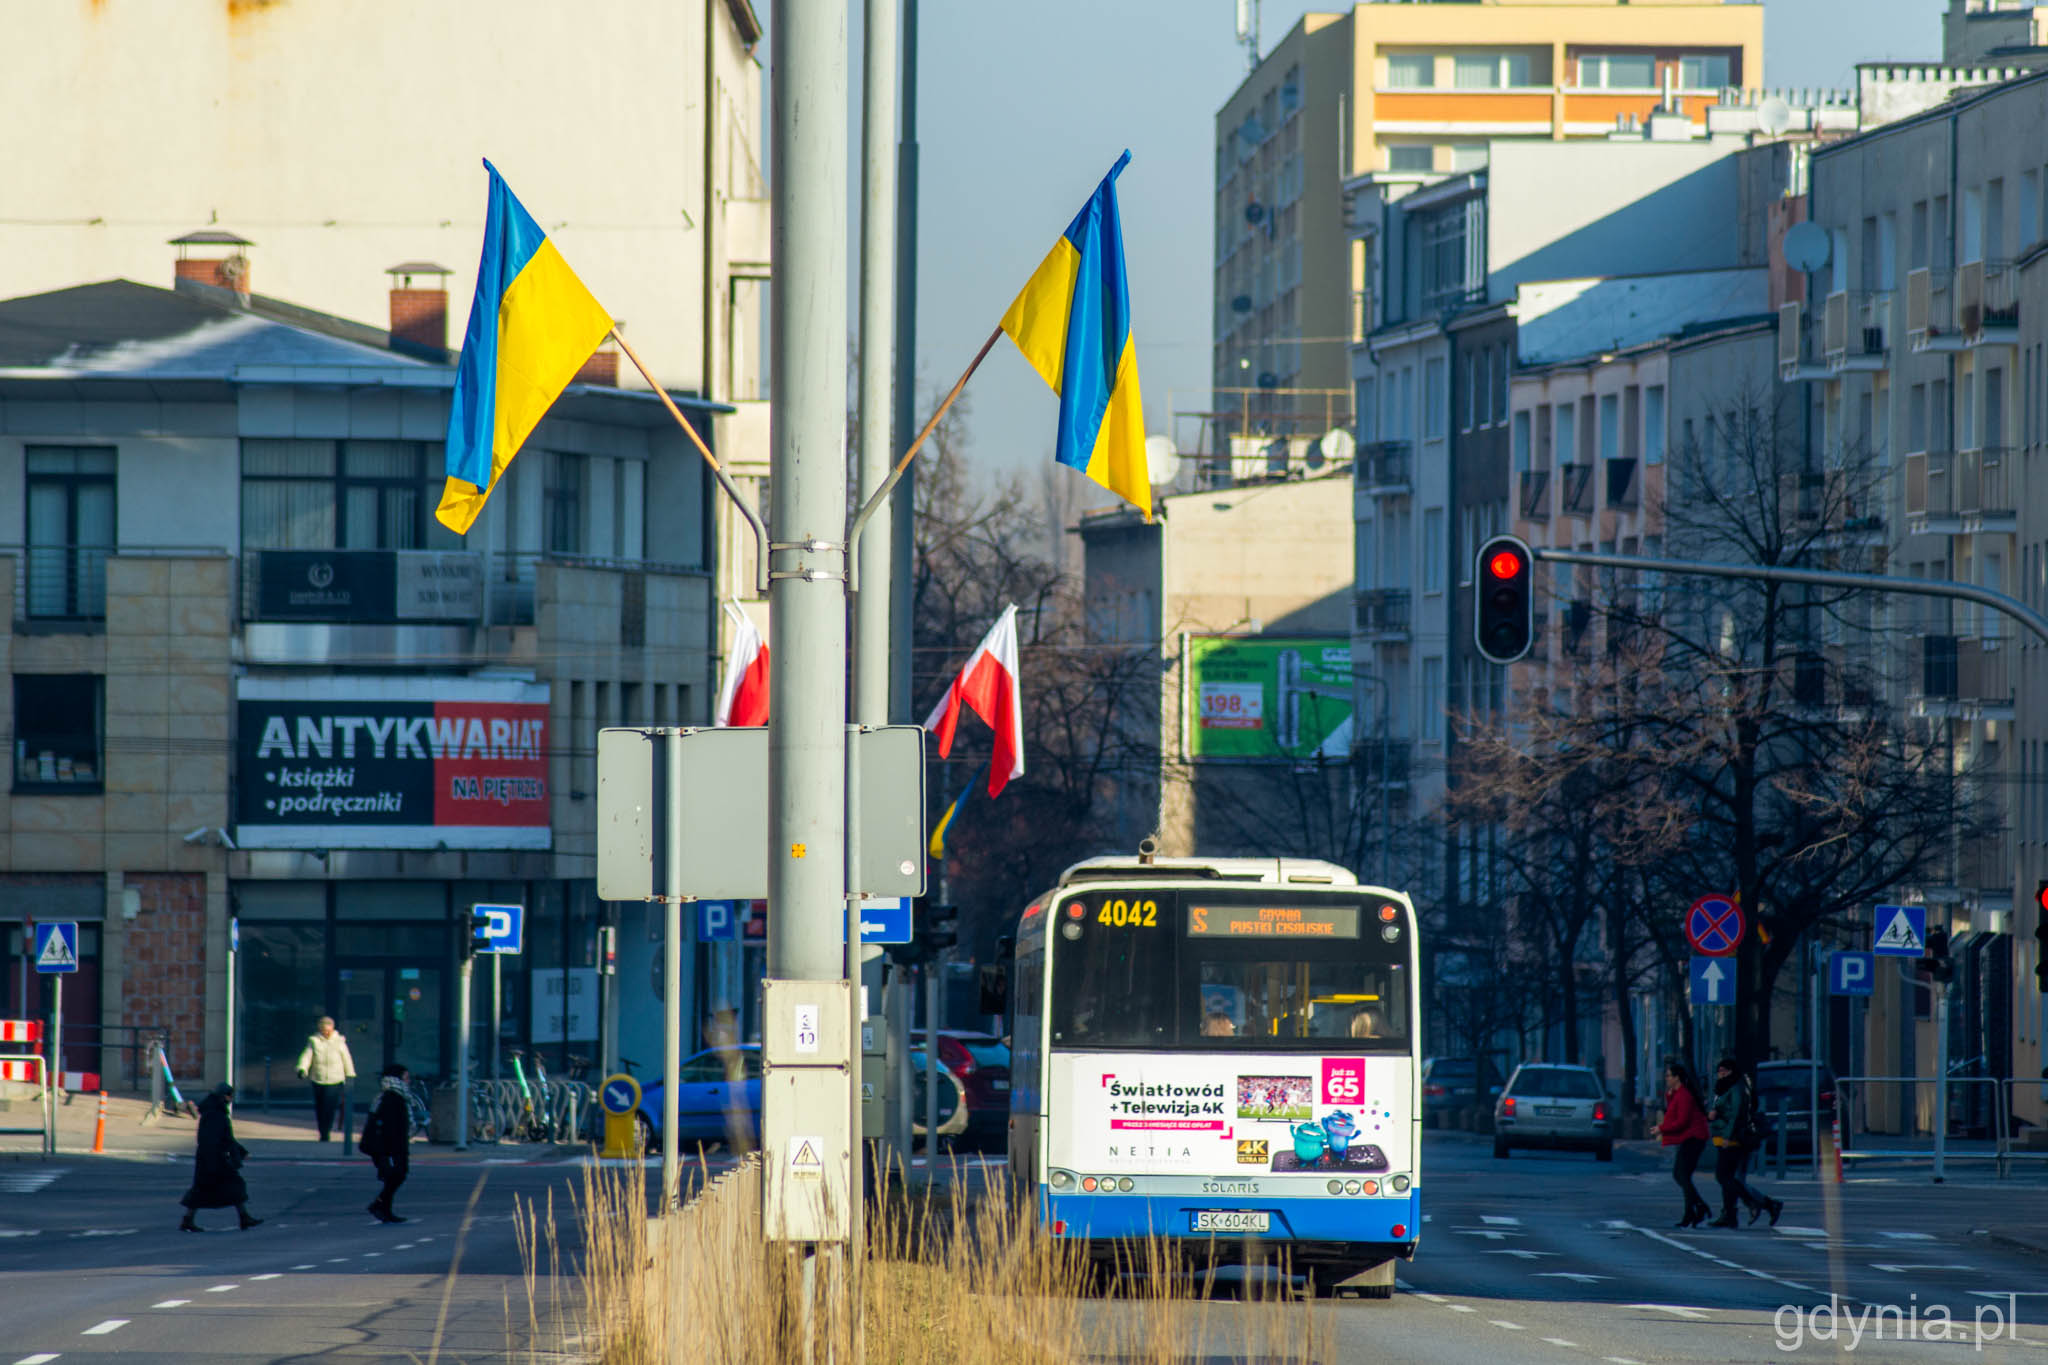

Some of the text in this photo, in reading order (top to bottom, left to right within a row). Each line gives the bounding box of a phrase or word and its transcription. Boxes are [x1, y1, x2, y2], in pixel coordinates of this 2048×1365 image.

[257, 716, 543, 760] ANTYKWARIAT
[279, 767, 355, 792] książki
[453, 776, 480, 800] NA
[279, 793, 402, 816] podręczniki
[1098, 900, 1157, 927] 4042
[1192, 907, 1208, 933] S
[1259, 908, 1301, 921] GDYNIA
[1230, 921, 1272, 933] PUSTKI
[1841, 957, 1865, 989] P
[1110, 1080, 1224, 1097] Światłowód
[1328, 1077, 1359, 1097] 65
[1202, 1102, 1224, 1114] 4K
[1109, 1146, 1191, 1156] NETIA
[1238, 1140, 1266, 1154] 4K
[1203, 1183, 1259, 1193] SOLARIS
